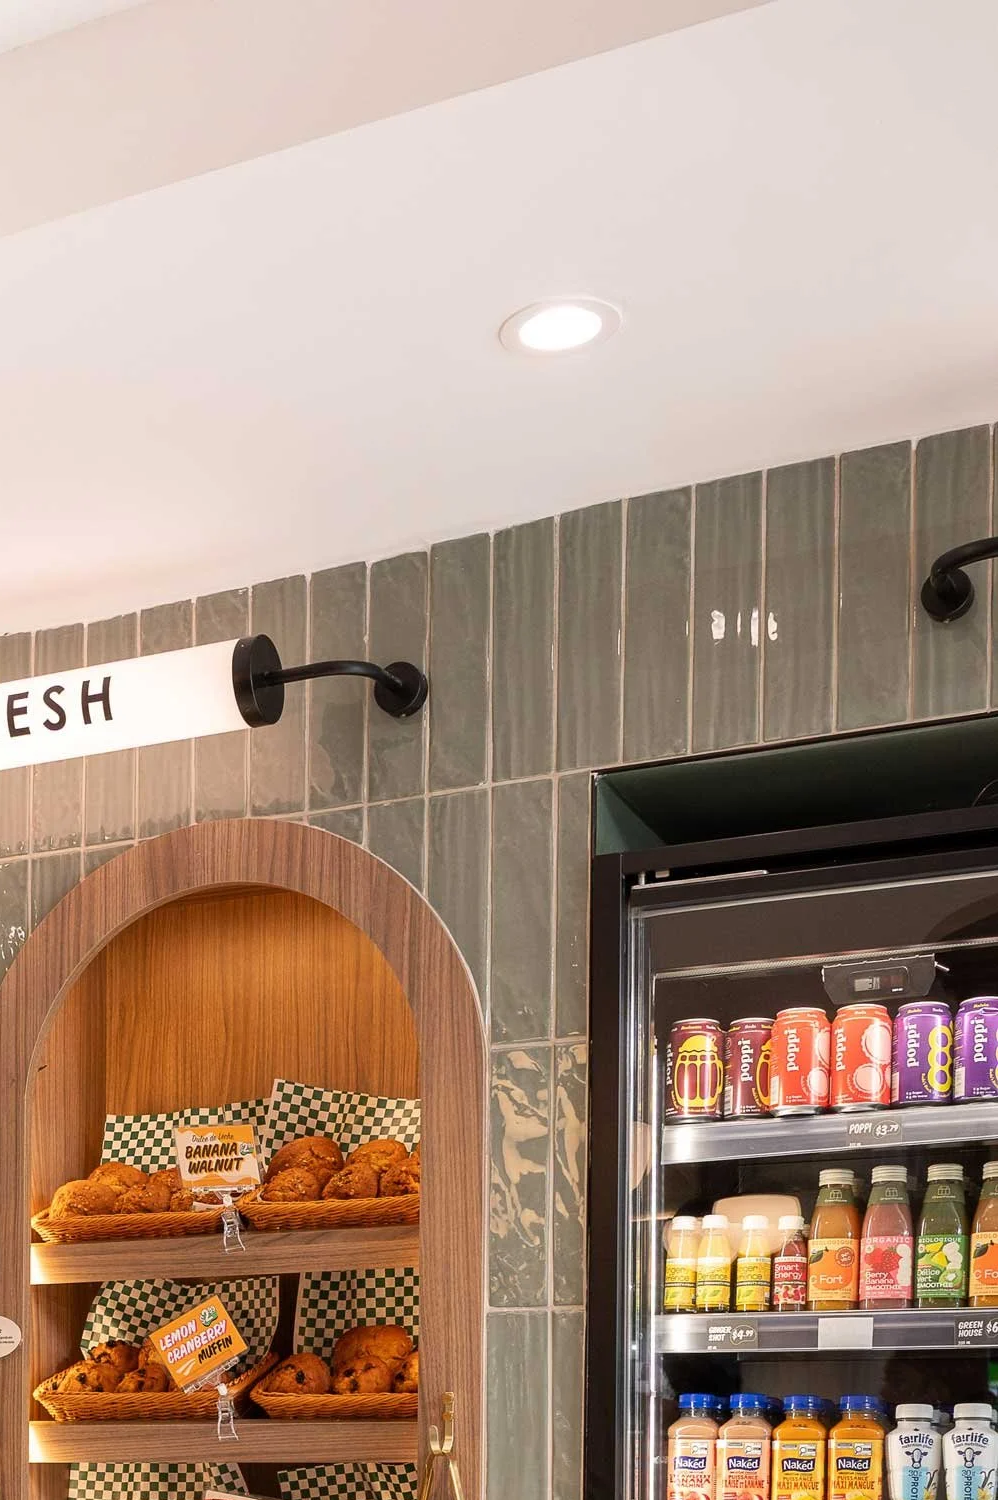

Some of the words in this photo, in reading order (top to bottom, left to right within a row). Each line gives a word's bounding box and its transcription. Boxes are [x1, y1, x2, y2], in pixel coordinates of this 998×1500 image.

[783, 1027, 800, 1072] poppi
[835, 1026, 846, 1072] poppi
[905, 1022, 920, 1068] poppi
[971, 1017, 988, 1063] poppi
[738, 1038, 754, 1082] poppi
[849, 1123, 872, 1134] POPPI
[185, 1142, 238, 1160] BANANA
[188, 1158, 244, 1175] WALNUT
[774, 1263, 800, 1272] Smart
[774, 1271, 802, 1280] Energy
[820, 1274, 842, 1284] Fort
[160, 1320, 198, 1351] LEMON
[958, 1321, 984, 1330] GREEN
[958, 1329, 984, 1337] HOUSE
[167, 1320, 228, 1364] CRANBERRY
[198, 1336, 233, 1364] MUFFIN
